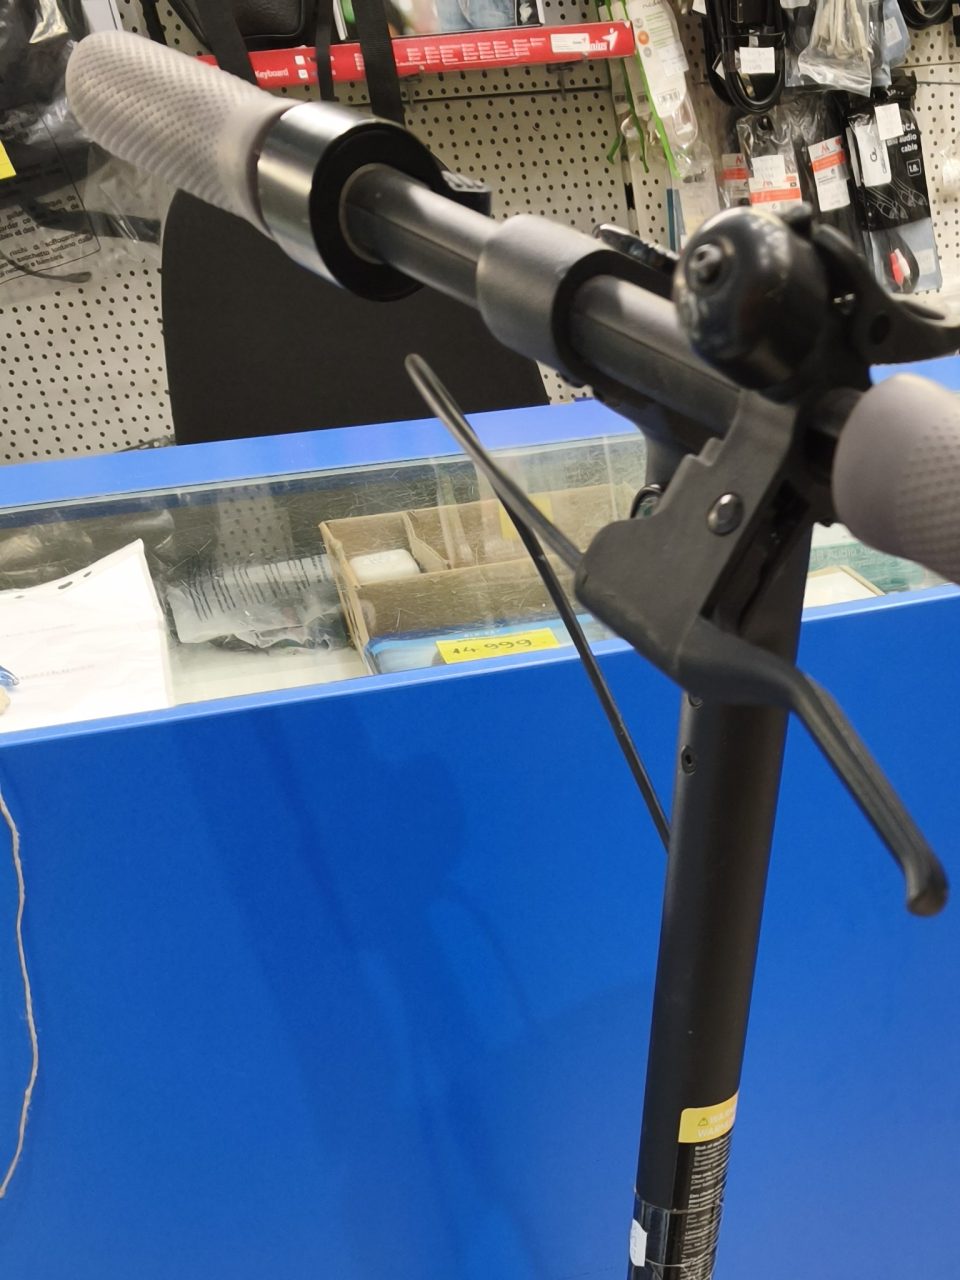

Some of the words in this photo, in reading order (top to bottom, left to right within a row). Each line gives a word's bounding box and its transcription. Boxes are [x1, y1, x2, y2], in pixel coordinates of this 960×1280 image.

[254, 68, 290, 80] Keyboard
[901, 143, 918, 153] cable
[484, 638, 532, 650] 999
